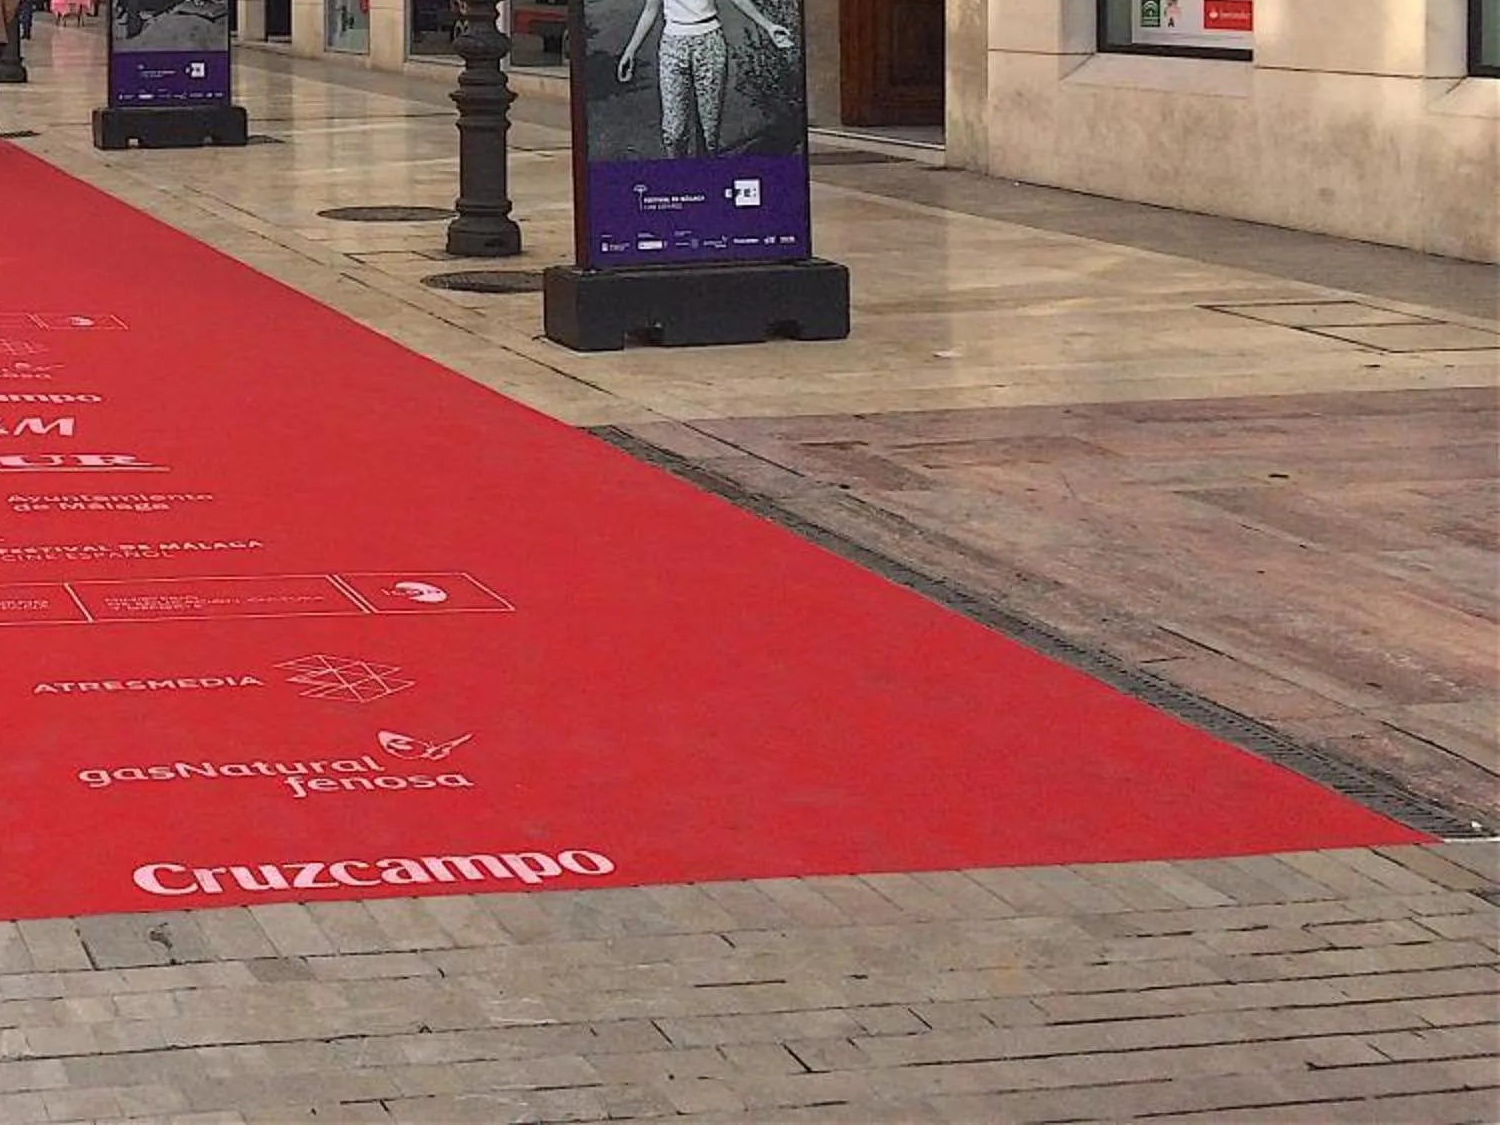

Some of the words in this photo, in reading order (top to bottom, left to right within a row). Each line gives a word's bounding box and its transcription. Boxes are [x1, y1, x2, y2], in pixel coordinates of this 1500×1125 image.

[33, 674, 264, 696] ATRESMEDIA
[77, 755, 385, 789] gasNatural
[284, 770, 475, 798] fenosa
[132, 848, 616, 897] Cruzcampo
